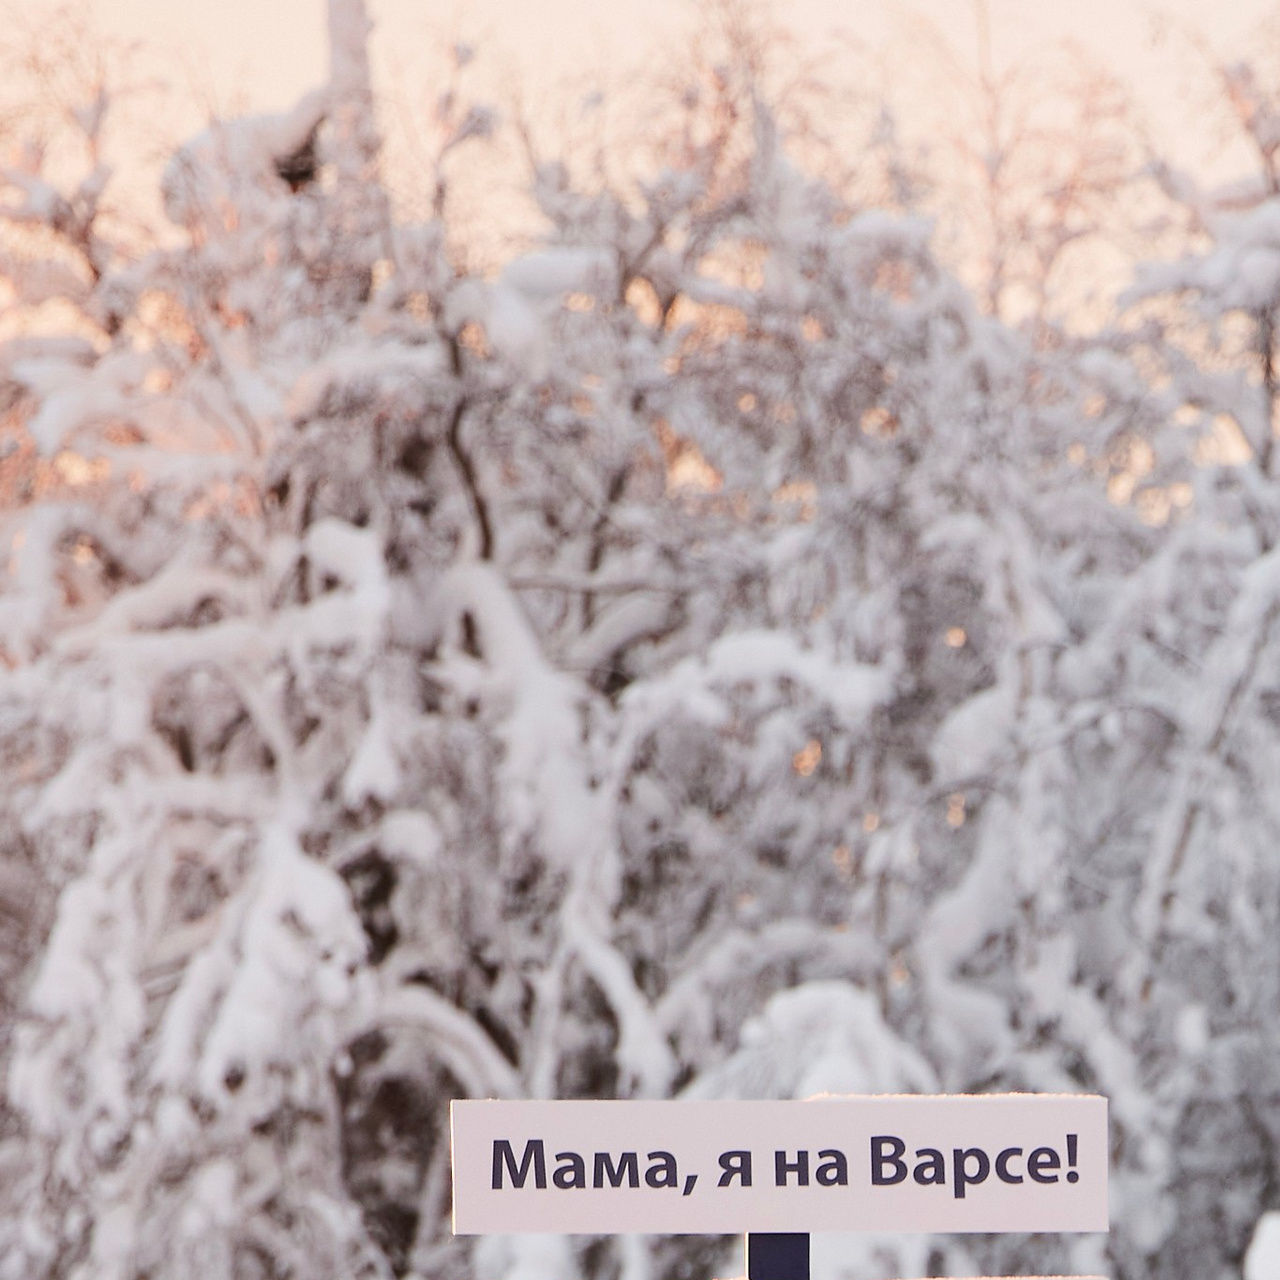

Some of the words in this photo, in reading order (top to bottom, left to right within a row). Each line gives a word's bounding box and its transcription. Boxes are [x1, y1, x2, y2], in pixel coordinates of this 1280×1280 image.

[491, 1139, 699, 1197] Мама,
[717, 1150, 753, 1188] я
[774, 1148, 849, 1187] на
[870, 1133, 1080, 1200] Варсе!
